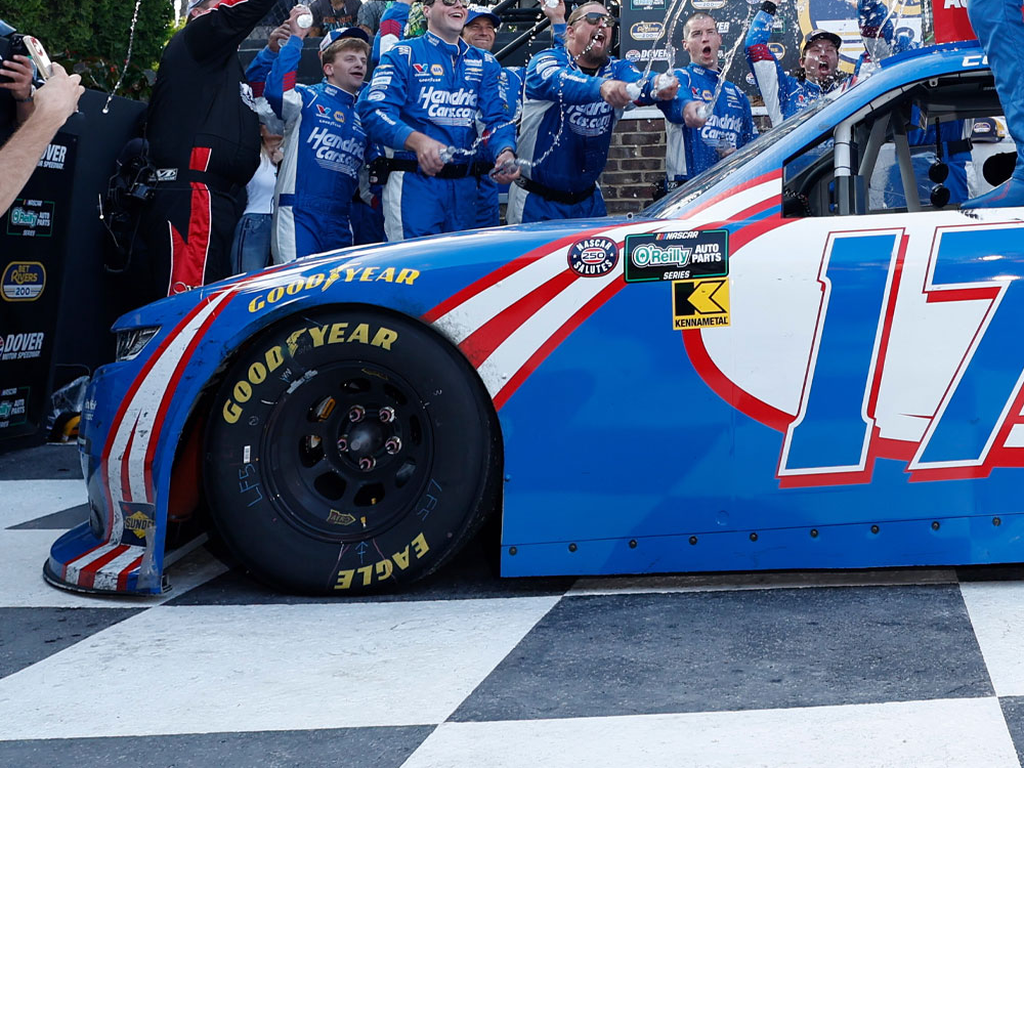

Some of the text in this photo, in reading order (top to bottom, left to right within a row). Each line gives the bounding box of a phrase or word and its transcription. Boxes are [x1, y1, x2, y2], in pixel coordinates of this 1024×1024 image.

[665, 231, 700, 241] NASCAR
[575, 238, 613, 251] NASCAR
[694, 243, 720, 254] AUTO
[582, 252, 605, 260] 250
[633, 244, 692, 268] O'Reilly
[691, 253, 722, 263] PARTS
[573, 260, 613, 275] SALUTES
[11, 269, 38, 284] RIVERS
[662, 270, 691, 280] SERIES
[15, 287, 31, 296] 200
[248, 262, 421, 313] GOODYEAR
[674, 316, 729, 328] KENNAMETAL
[4, 333, 44, 352] DOVER
[222, 322, 399, 424] GOODYEAR
[334, 532, 430, 590] EAGLE
